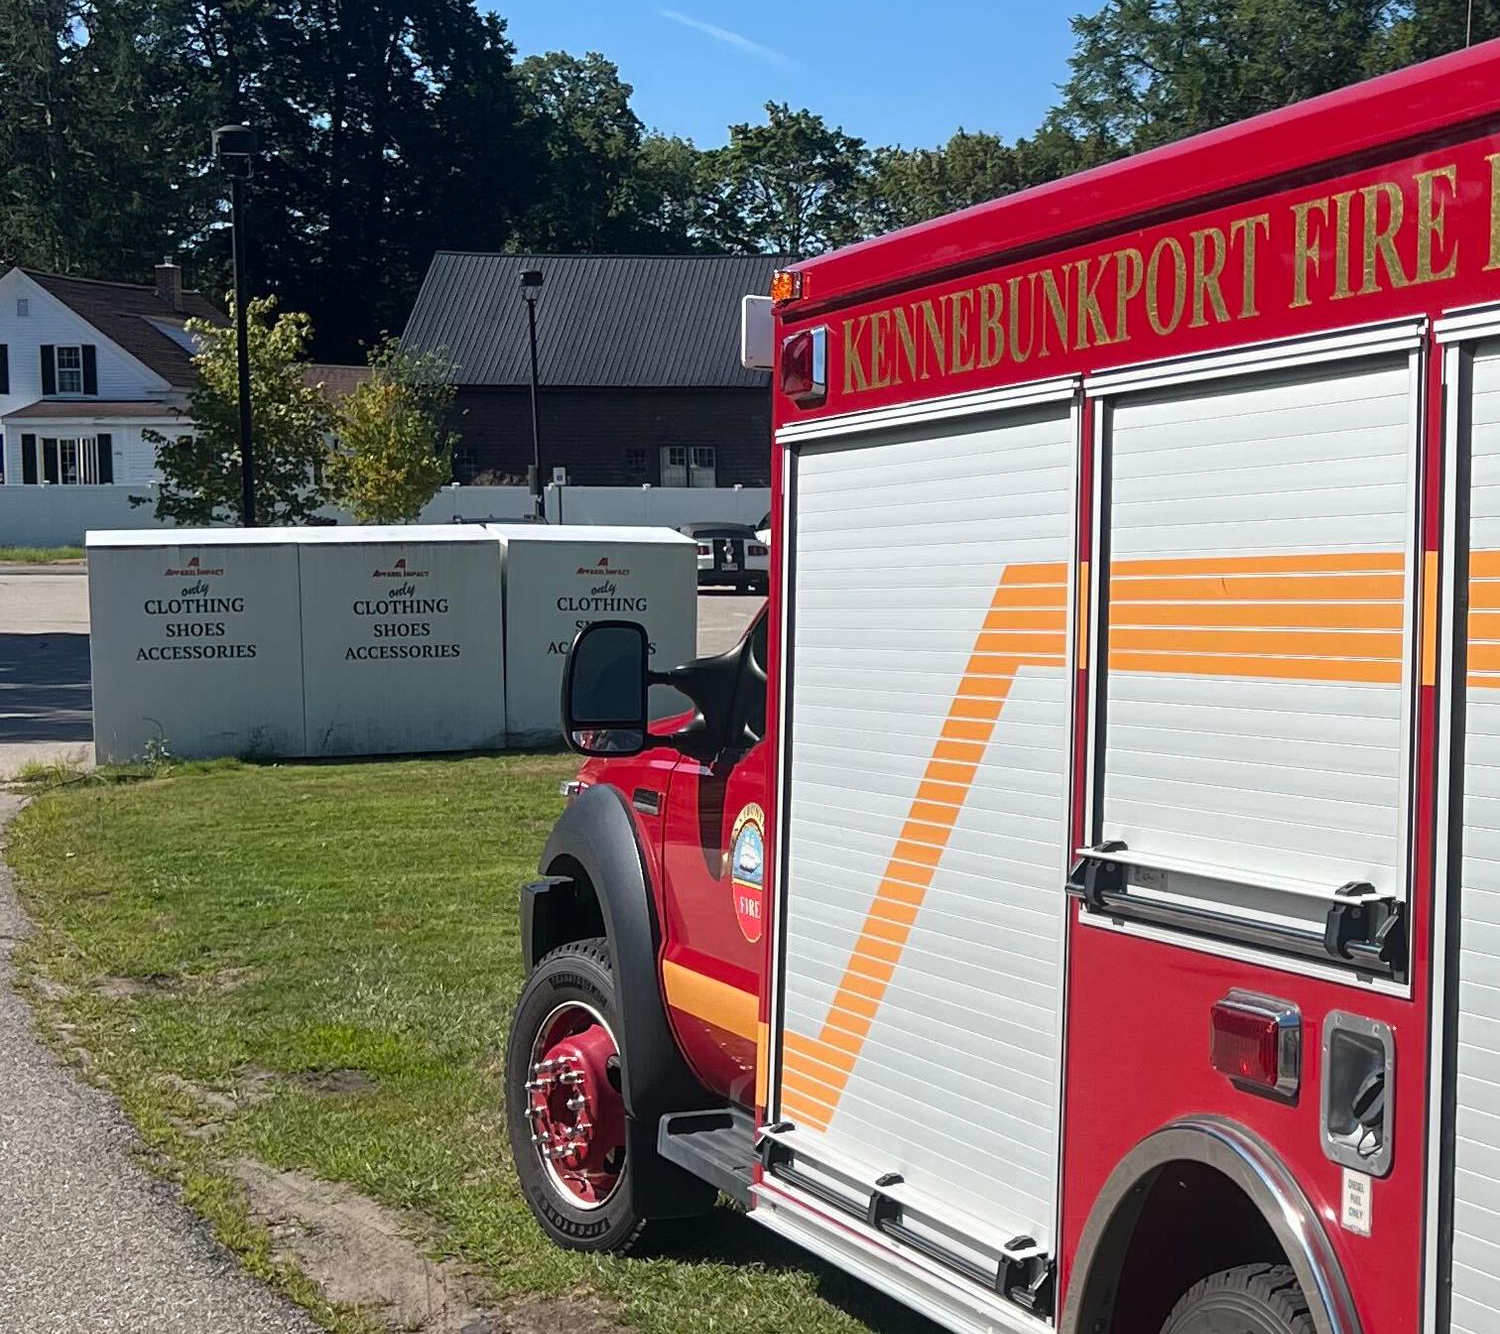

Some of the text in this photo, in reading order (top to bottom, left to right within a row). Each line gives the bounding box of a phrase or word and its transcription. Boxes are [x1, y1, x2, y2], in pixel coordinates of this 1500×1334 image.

[840, 216, 1272, 395] KENNEBUNKPORT
[1289, 164, 1459, 309] FIRE
[181, 580, 209, 597] only
[388, 582, 416, 598] only
[591, 580, 616, 596] only
[144, 597, 245, 615] CLOTHING
[353, 598, 449, 615] CLOTHING
[556, 597, 647, 612] CLOTHING
[166, 623, 225, 637] SHOES
[373, 623, 431, 637] SHOES
[136, 644, 257, 661] ACCESSORIES
[345, 644, 461, 660] ACCESSORIES
[739, 896, 761, 920] FIRE
